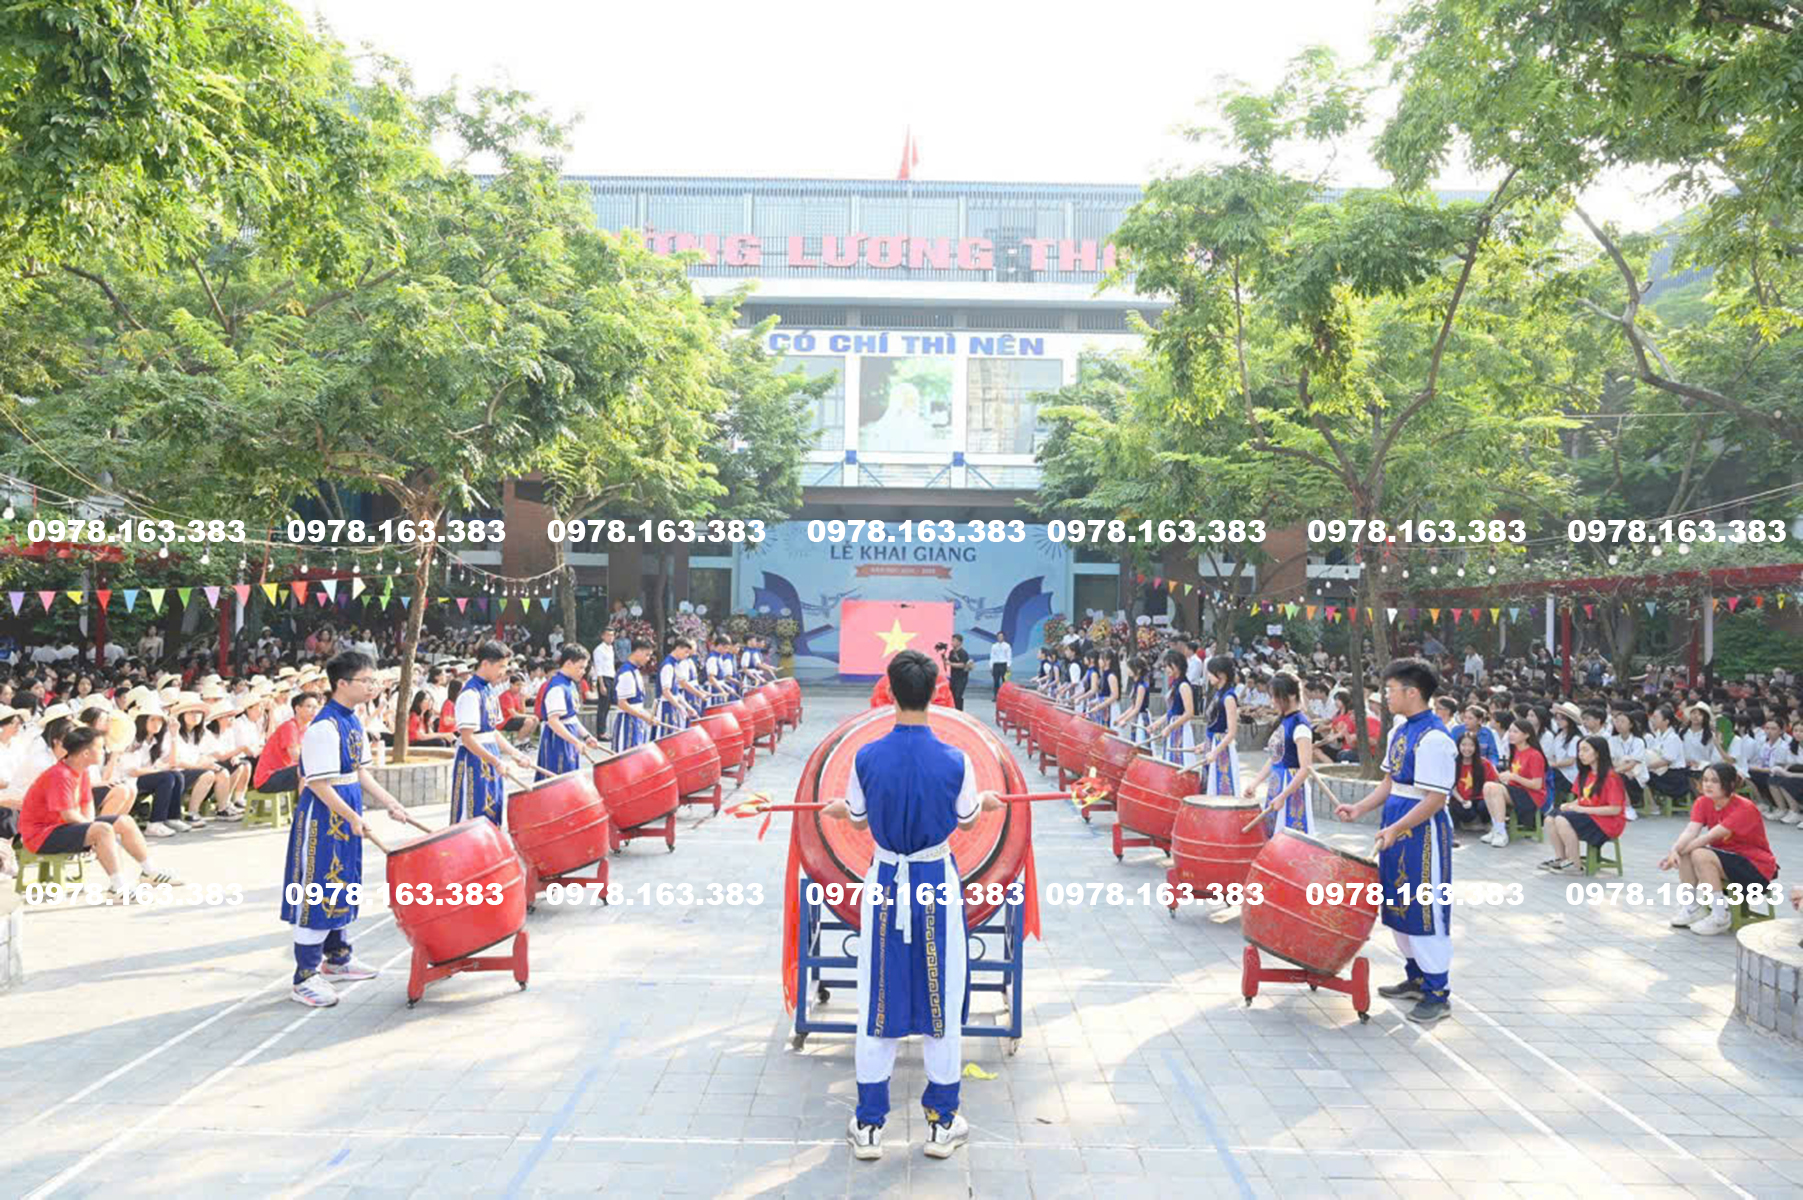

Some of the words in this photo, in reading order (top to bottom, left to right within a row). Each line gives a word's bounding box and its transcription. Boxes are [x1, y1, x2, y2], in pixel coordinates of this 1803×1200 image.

[788, 233, 994, 270] LƯƠNG
[769, 330, 816, 352] CÓ
[829, 332, 890, 354] CHÍ
[901, 332, 956, 355] THÌ
[969, 334, 1045, 356] NÊN
[860, 545, 907, 561] KHAI
